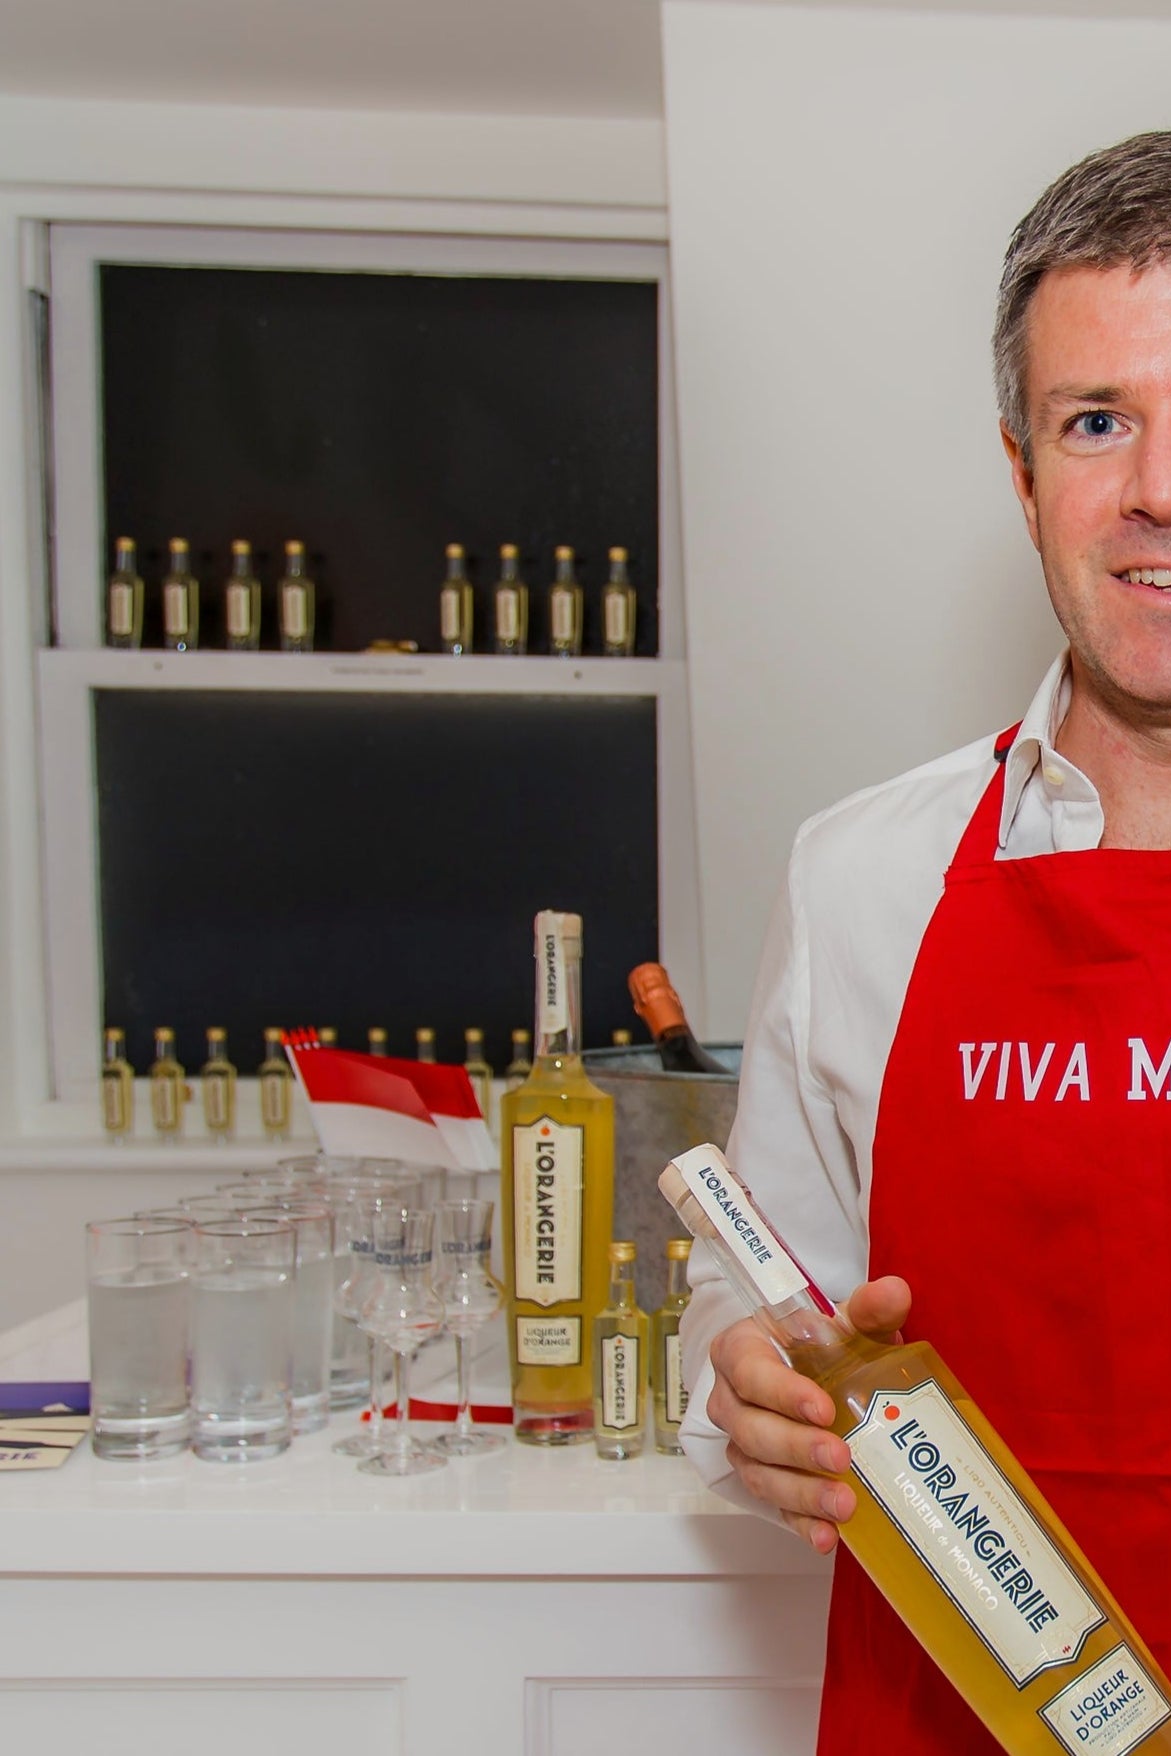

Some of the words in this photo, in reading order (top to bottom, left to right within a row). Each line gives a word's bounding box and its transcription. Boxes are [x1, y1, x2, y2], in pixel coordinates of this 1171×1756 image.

[959, 1042, 1090, 1101] VIVA
[536, 1141, 554, 1284] L'ORANGERIE
[698, 1166, 773, 1264] L'ORANGERIE
[890, 1419, 1059, 1634] L'ORANGERIE
[894, 1472, 944, 1534] LIQUEUR
[937, 1535, 949, 1547] de
[947, 1545, 998, 1610] MONACO
[1070, 1669, 1129, 1722] LIQUEUR
[1076, 1681, 1144, 1741] D'ORANGE
